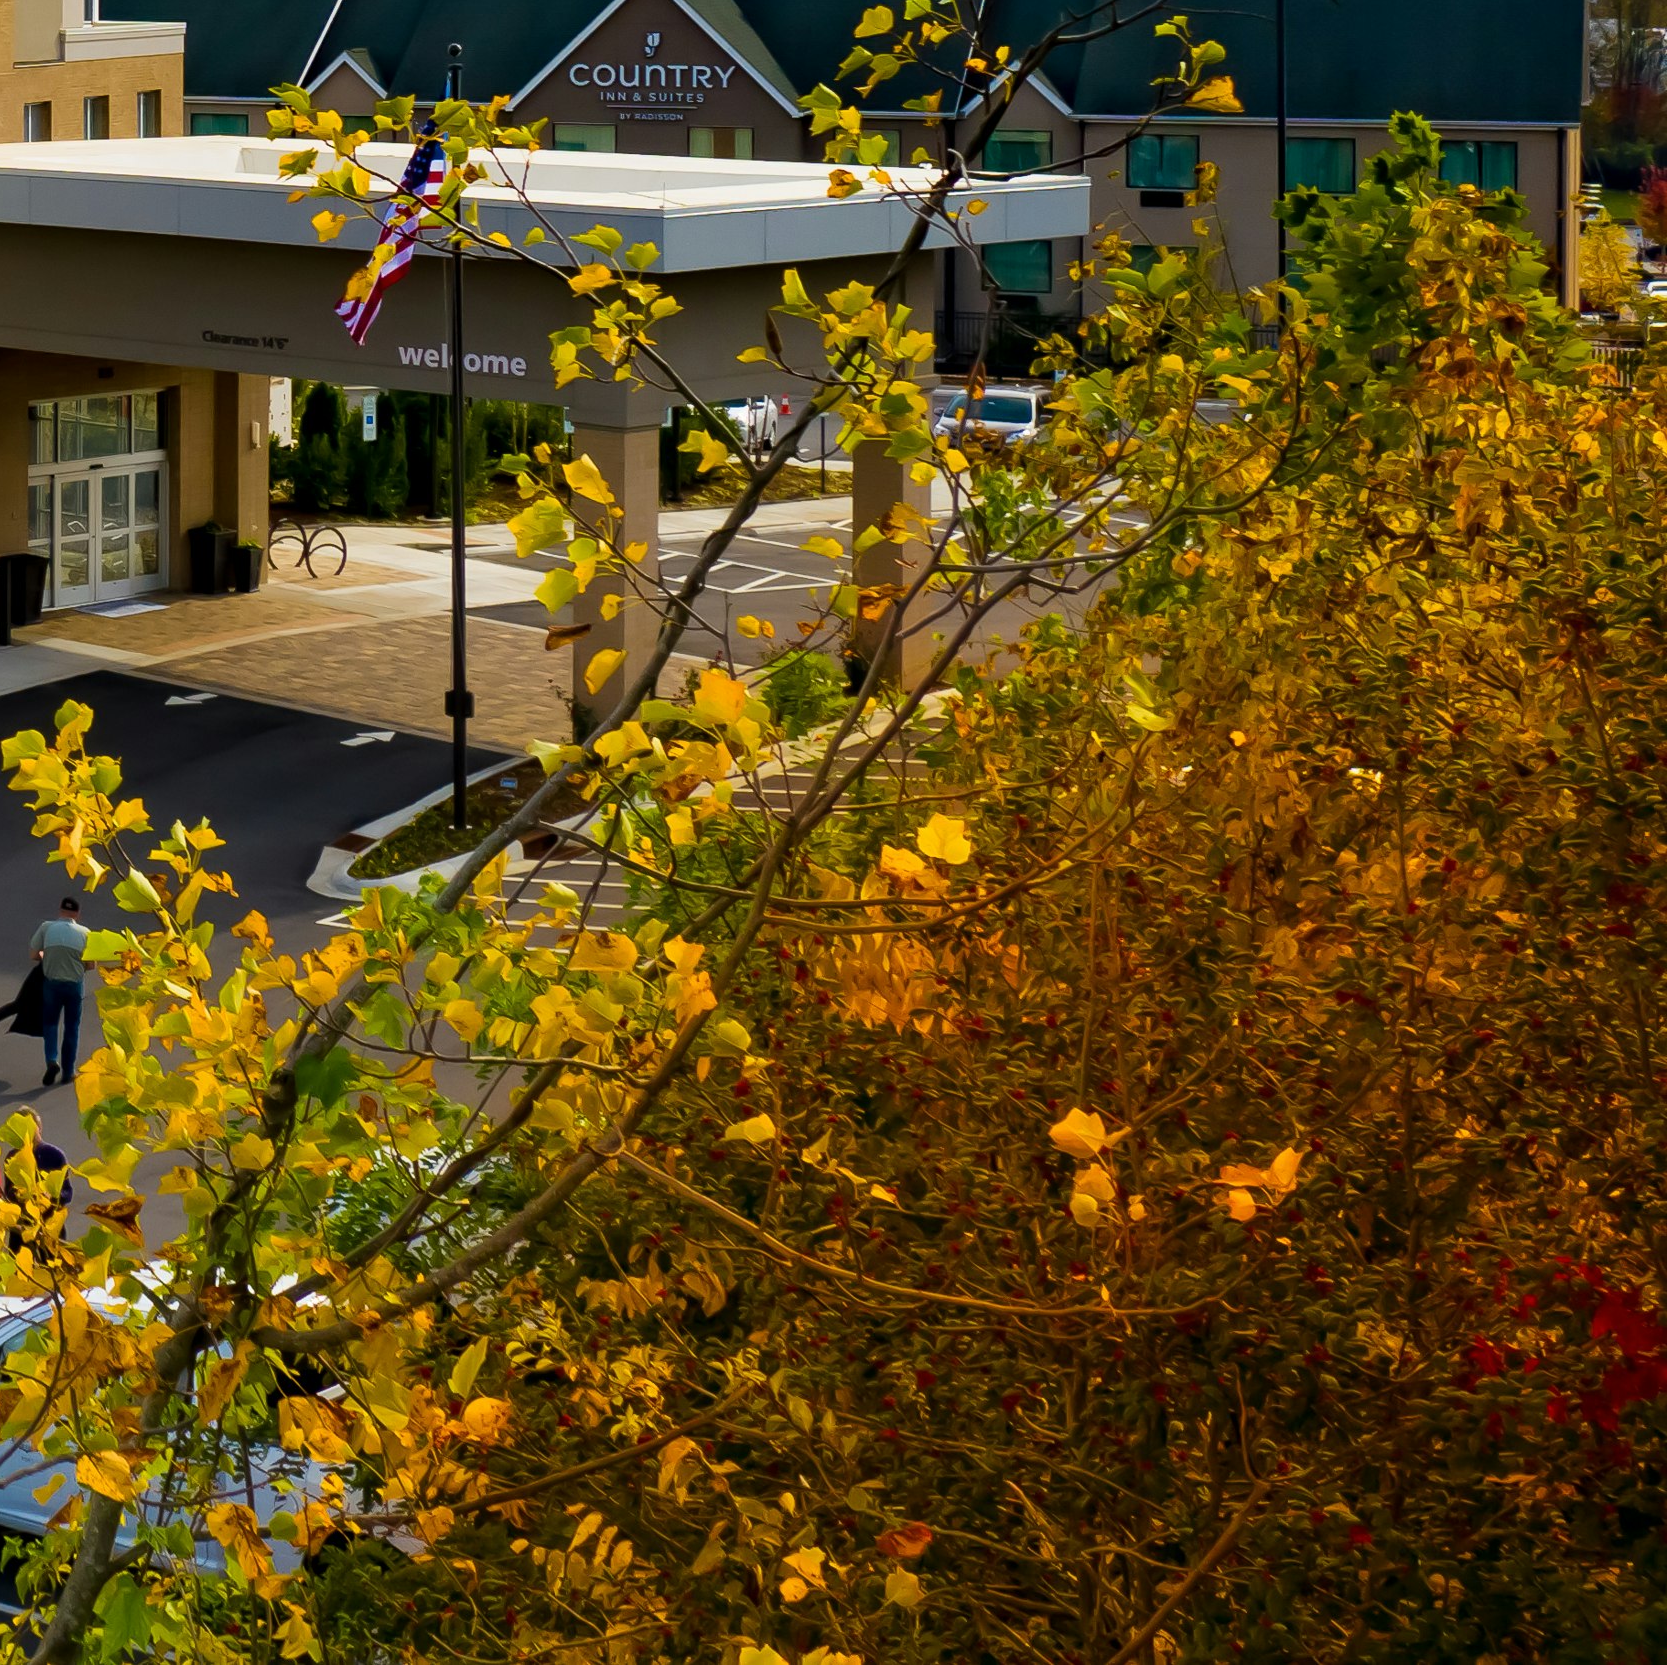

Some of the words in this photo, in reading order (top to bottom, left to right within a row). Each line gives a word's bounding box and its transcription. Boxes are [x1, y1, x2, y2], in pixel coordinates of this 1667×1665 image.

[600, 91, 627, 102] INN
[632, 92, 642, 102] &
[648, 92, 705, 103] SUITES
[619, 112, 632, 120] BY
[634, 113, 684, 121] RADISSON
[202, 330, 260, 348] Clearance
[398, 342, 527, 376] welome
